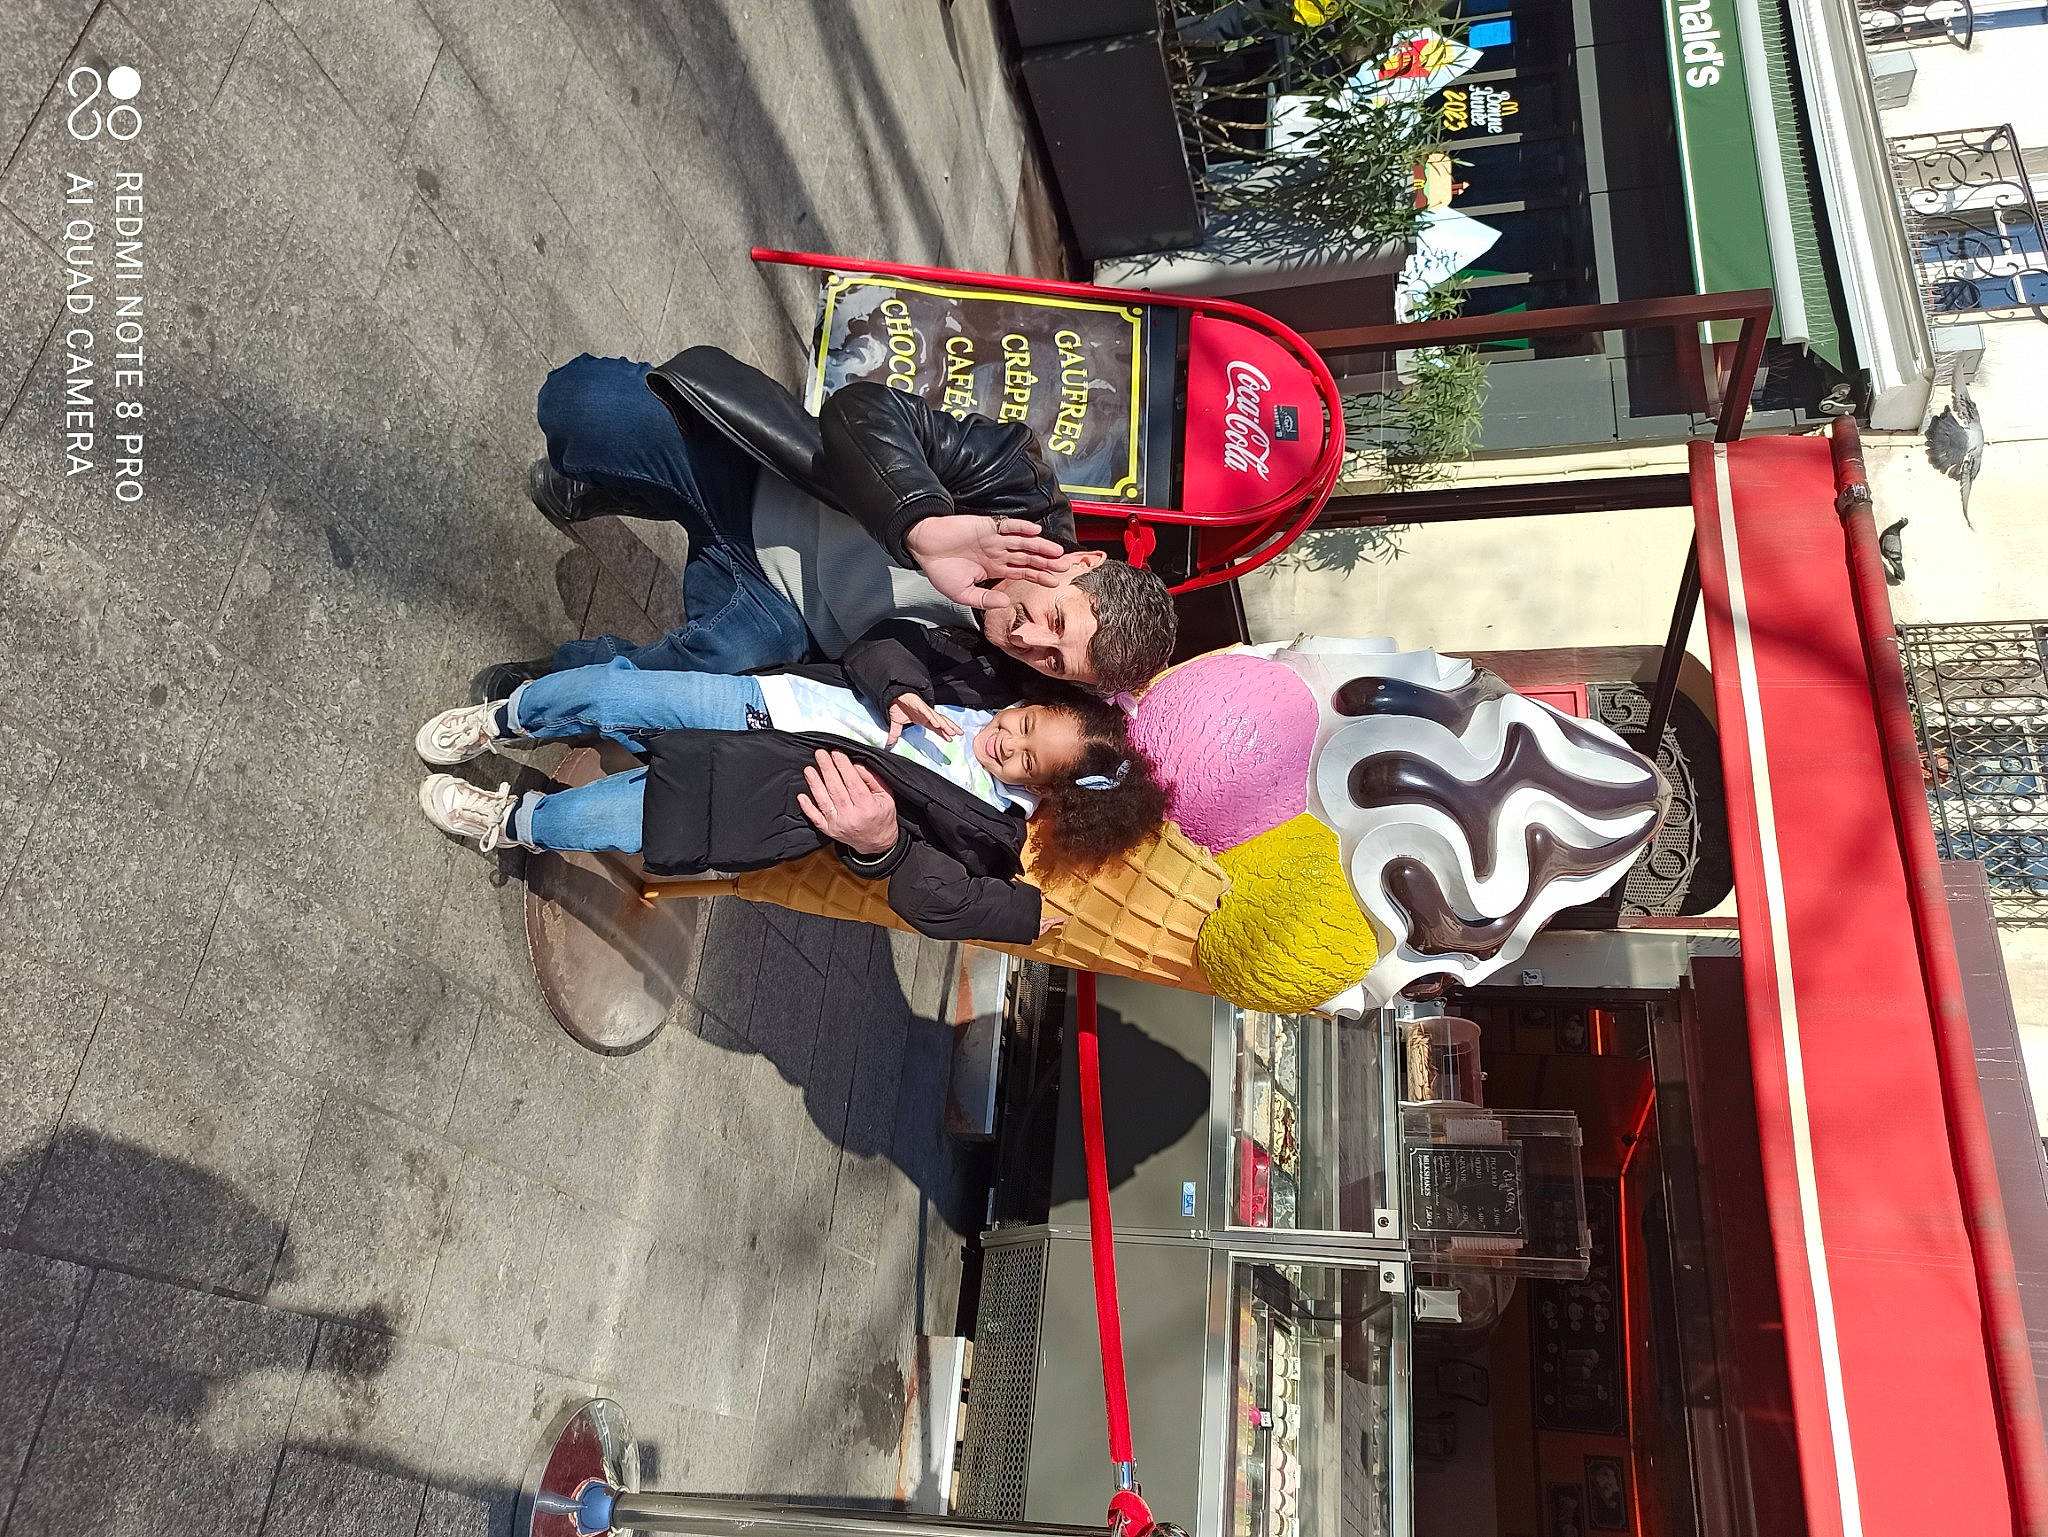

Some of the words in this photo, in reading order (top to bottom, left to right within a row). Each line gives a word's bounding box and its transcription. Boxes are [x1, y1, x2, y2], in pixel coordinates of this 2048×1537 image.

[1443, 90, 1468, 132] 2023
[1469, 84, 1493, 127] Année
[1486, 91, 1510, 134] Bonne
[997, 334, 1039, 424] CRÊPE
[1047, 331, 1090, 456] GAUFRES
[1223, 360, 1271, 482] Coca-Cola
[1423, 1154, 1432, 1197] MILKSHAKES
